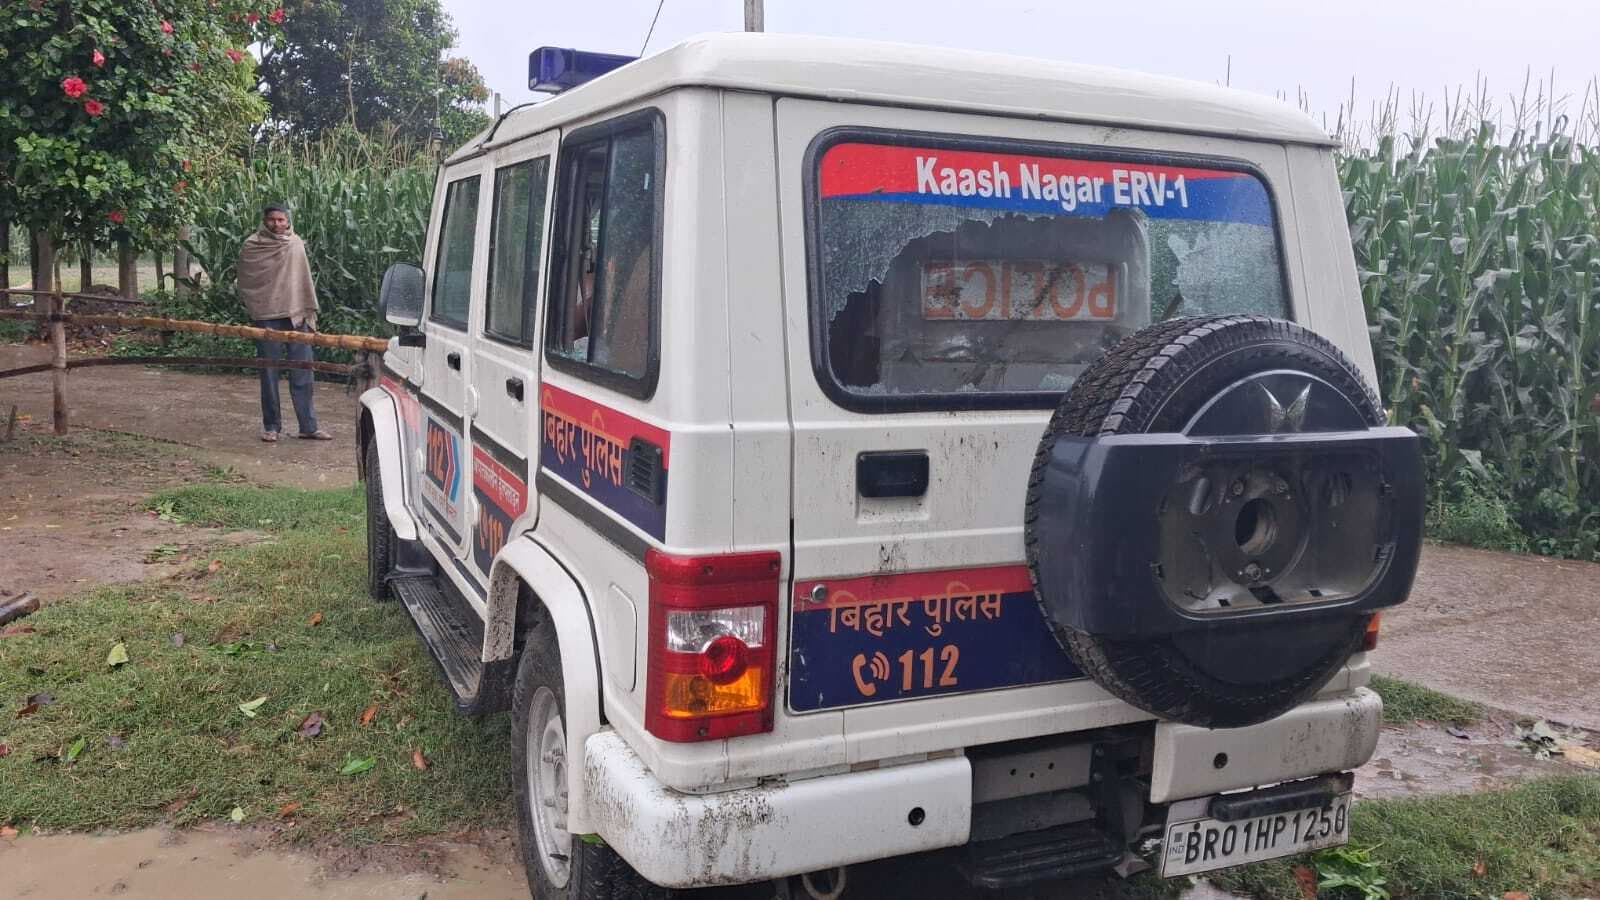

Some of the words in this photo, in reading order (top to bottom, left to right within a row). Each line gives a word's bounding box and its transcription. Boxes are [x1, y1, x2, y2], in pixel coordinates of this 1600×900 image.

[916, 156, 1010, 199] Kaash
[1019, 163, 1104, 212] Nagar
[1112, 168, 1189, 208] ERV-1
[926, 261, 1117, 318] POLICE
[427, 423, 445, 481] 112
[541, 389, 576, 465] बिहार
[580, 408, 625, 489] पुलिस
[829, 590, 914, 637] बिहार
[921, 581, 1004, 637] पुलिस
[899, 644, 960, 691] 112
[1185, 803, 1346, 865] BR01HP1250
